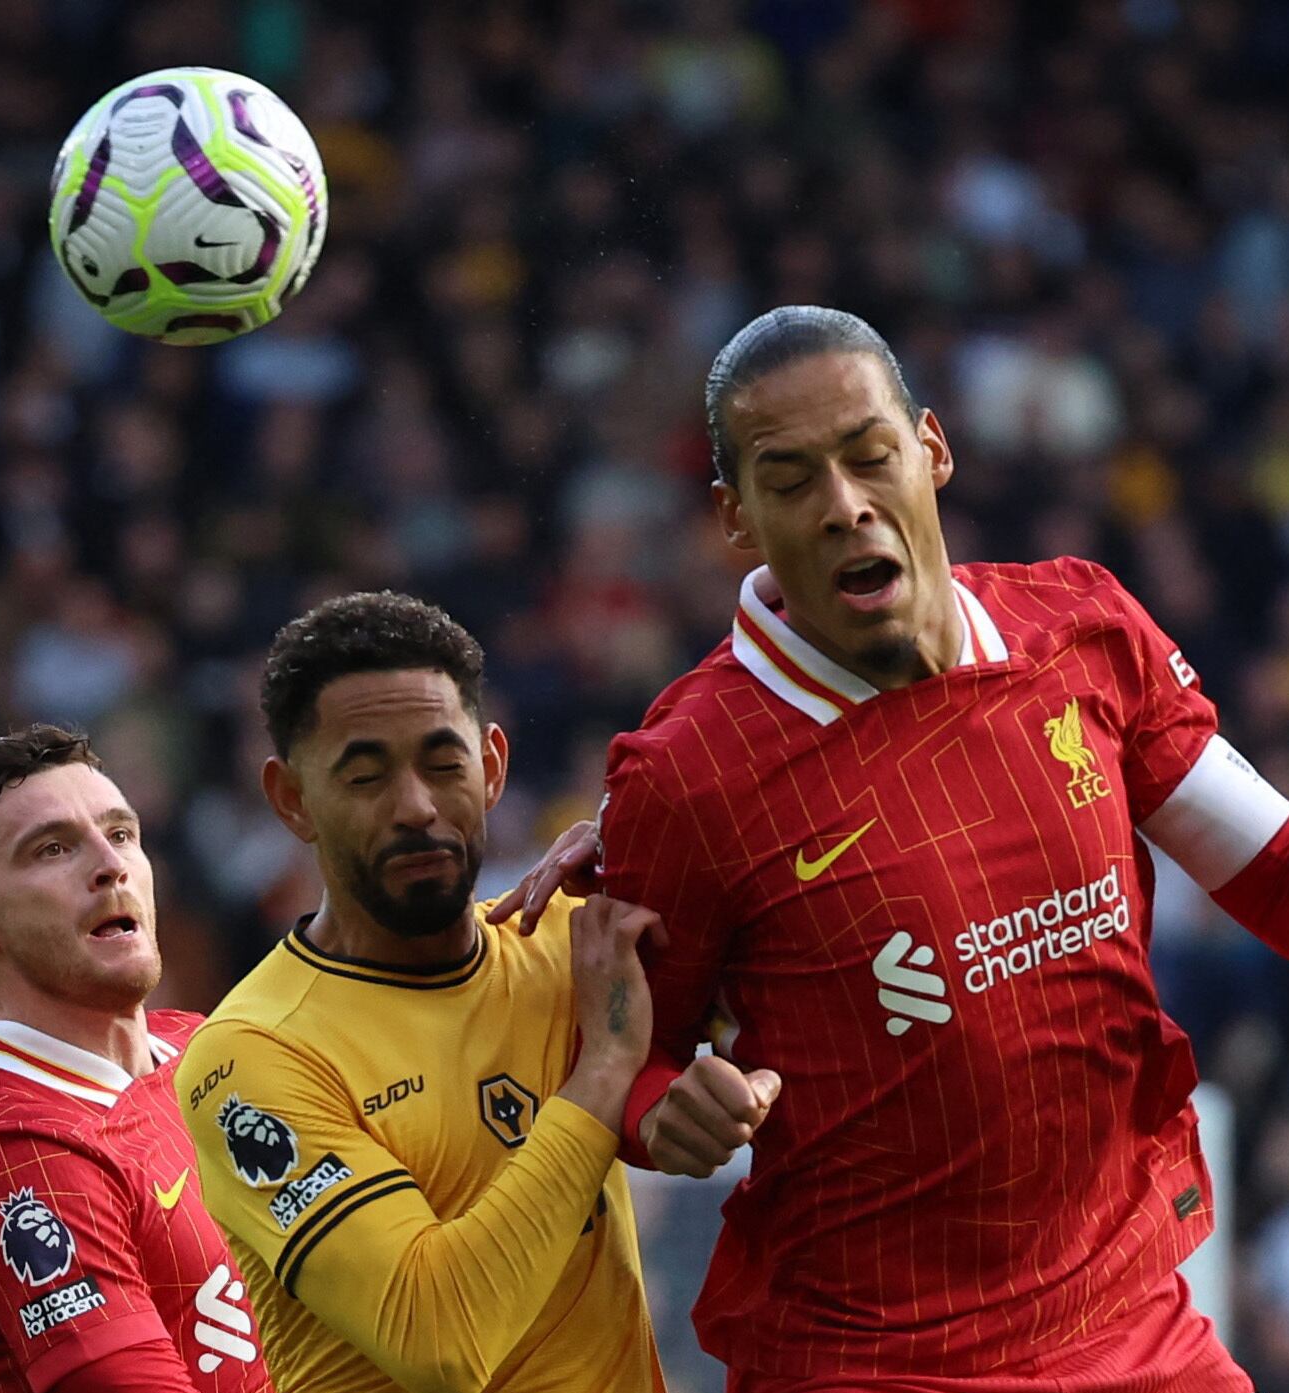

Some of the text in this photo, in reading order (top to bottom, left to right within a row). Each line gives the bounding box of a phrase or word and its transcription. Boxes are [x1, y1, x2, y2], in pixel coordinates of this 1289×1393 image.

[955, 865, 1119, 961] standard
[965, 895, 1130, 993] chartered
[191, 1060, 234, 1110] SUDU
[363, 1075, 425, 1116] SUDU
[270, 1162, 336, 1214] No room
[277, 1167, 354, 1231] for racism
[19, 1282, 91, 1323] No room
[25, 1293, 106, 1339] for racism
